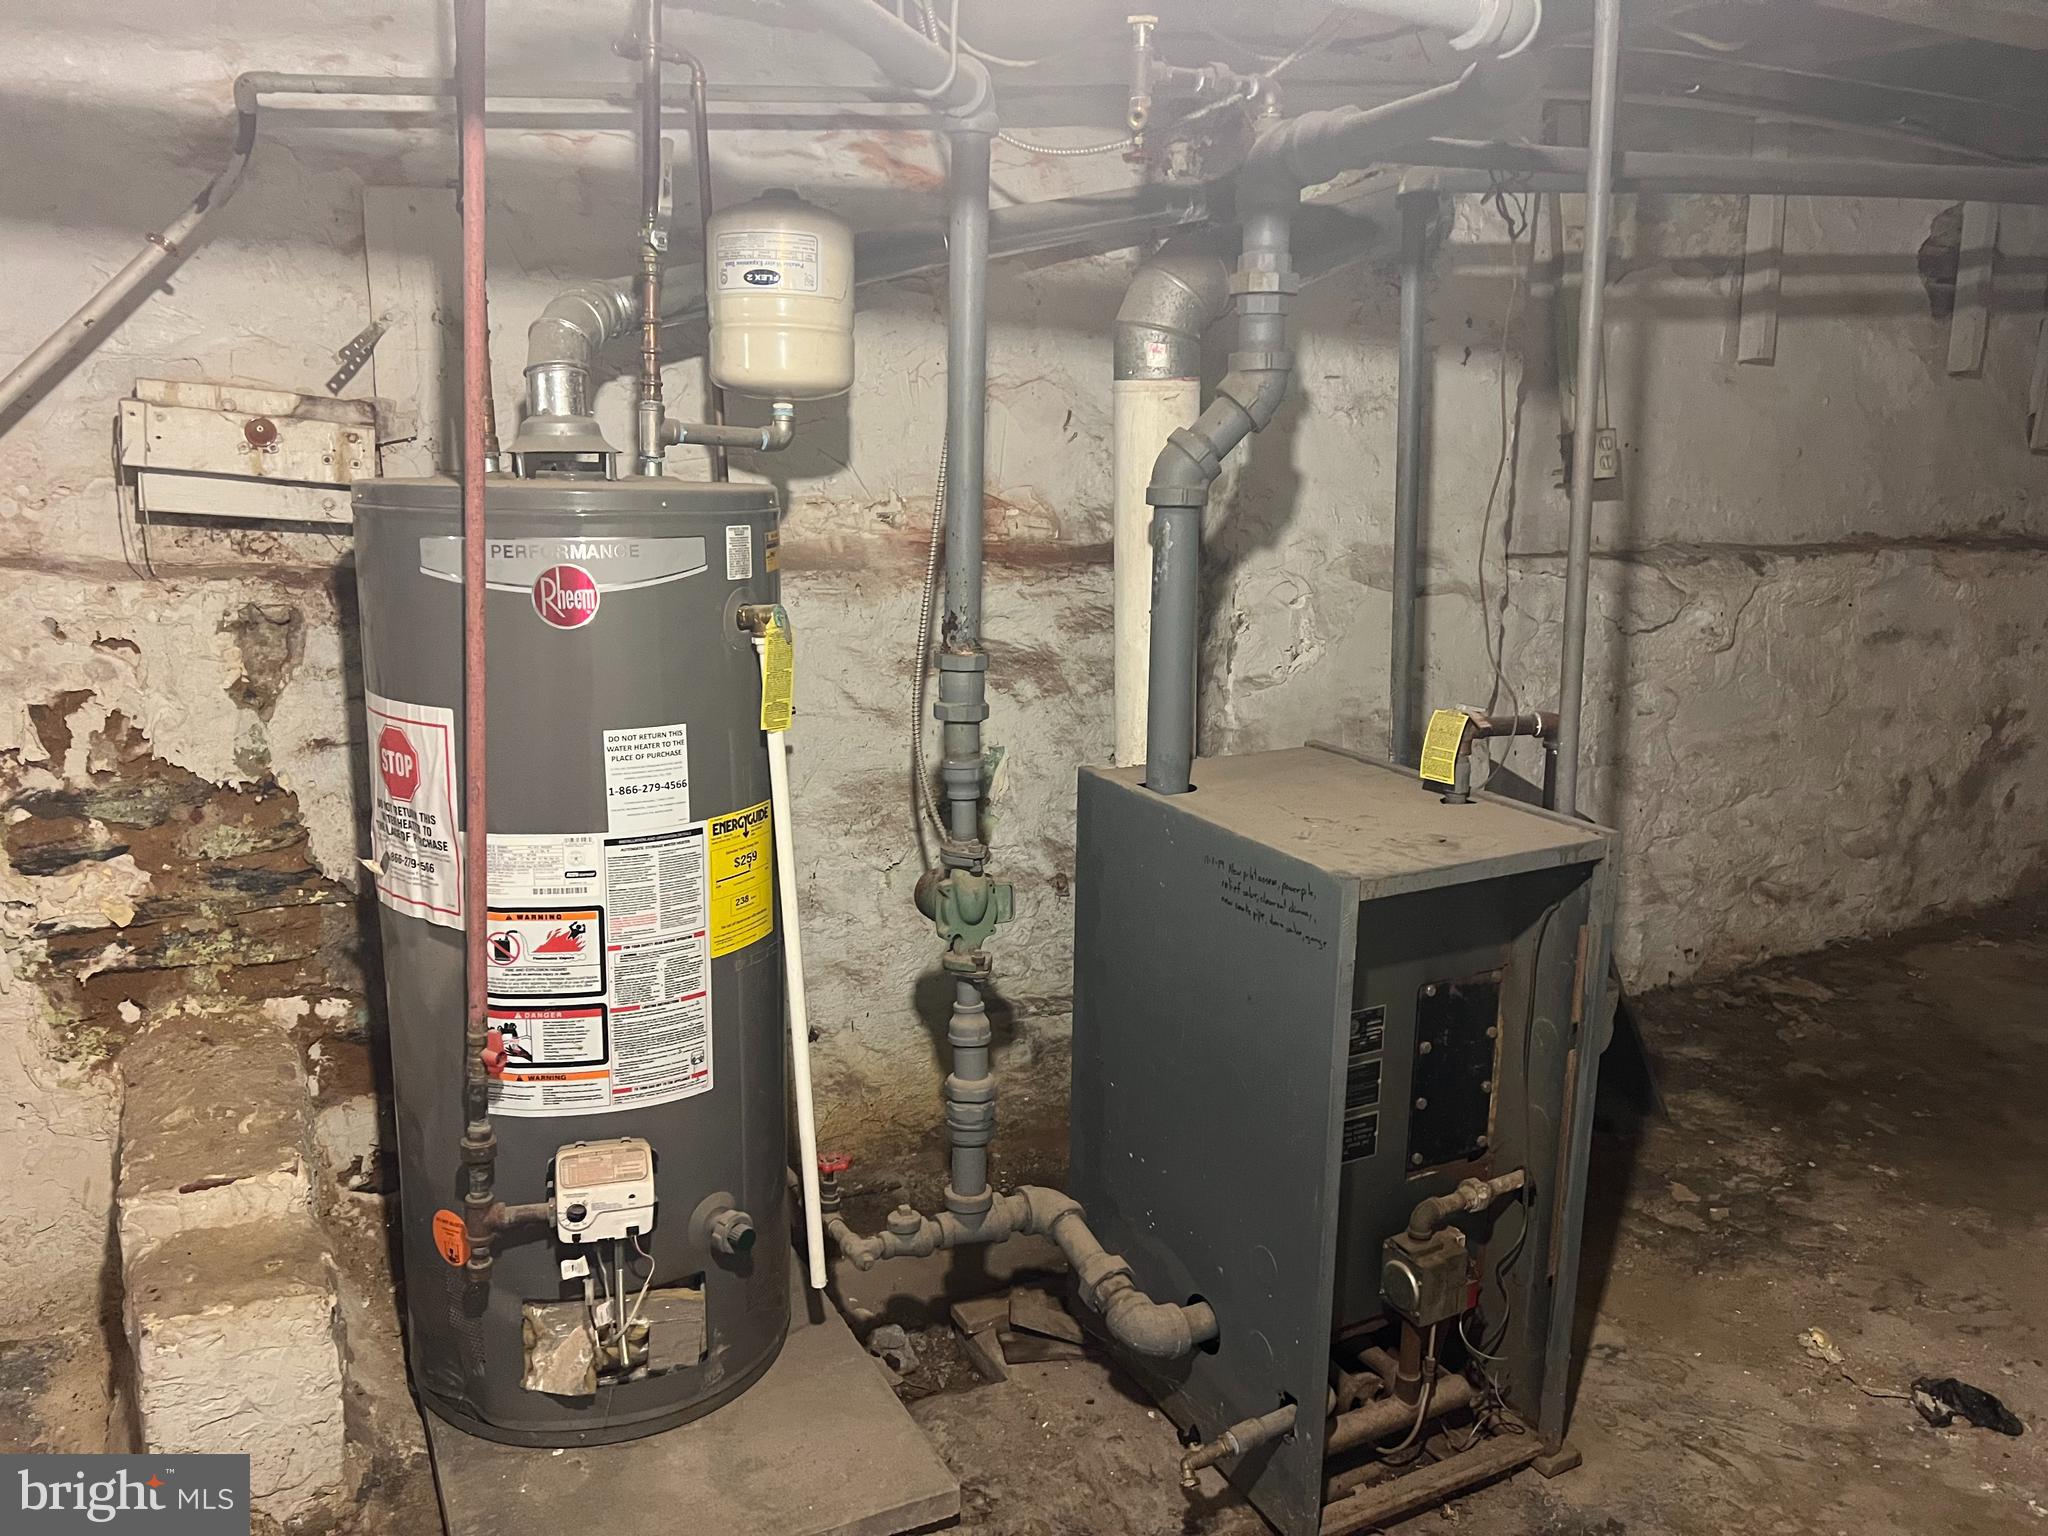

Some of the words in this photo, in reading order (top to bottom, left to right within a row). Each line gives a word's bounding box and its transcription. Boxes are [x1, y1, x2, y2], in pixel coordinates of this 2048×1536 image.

[491, 544, 640, 560] PERFORMANCE
[540, 566, 595, 618] Rheem
[638, 732, 666, 740] RETURN
[647, 749, 682, 759] PURCHASE
[382, 748, 414, 778] STOP
[608, 779, 688, 796] 1-866-279-4566
[419, 812, 436, 825] THIS
[712, 806, 769, 837] ENERGYGUIDE
[423, 826, 432, 837] TO
[736, 894, 749, 907] 238
